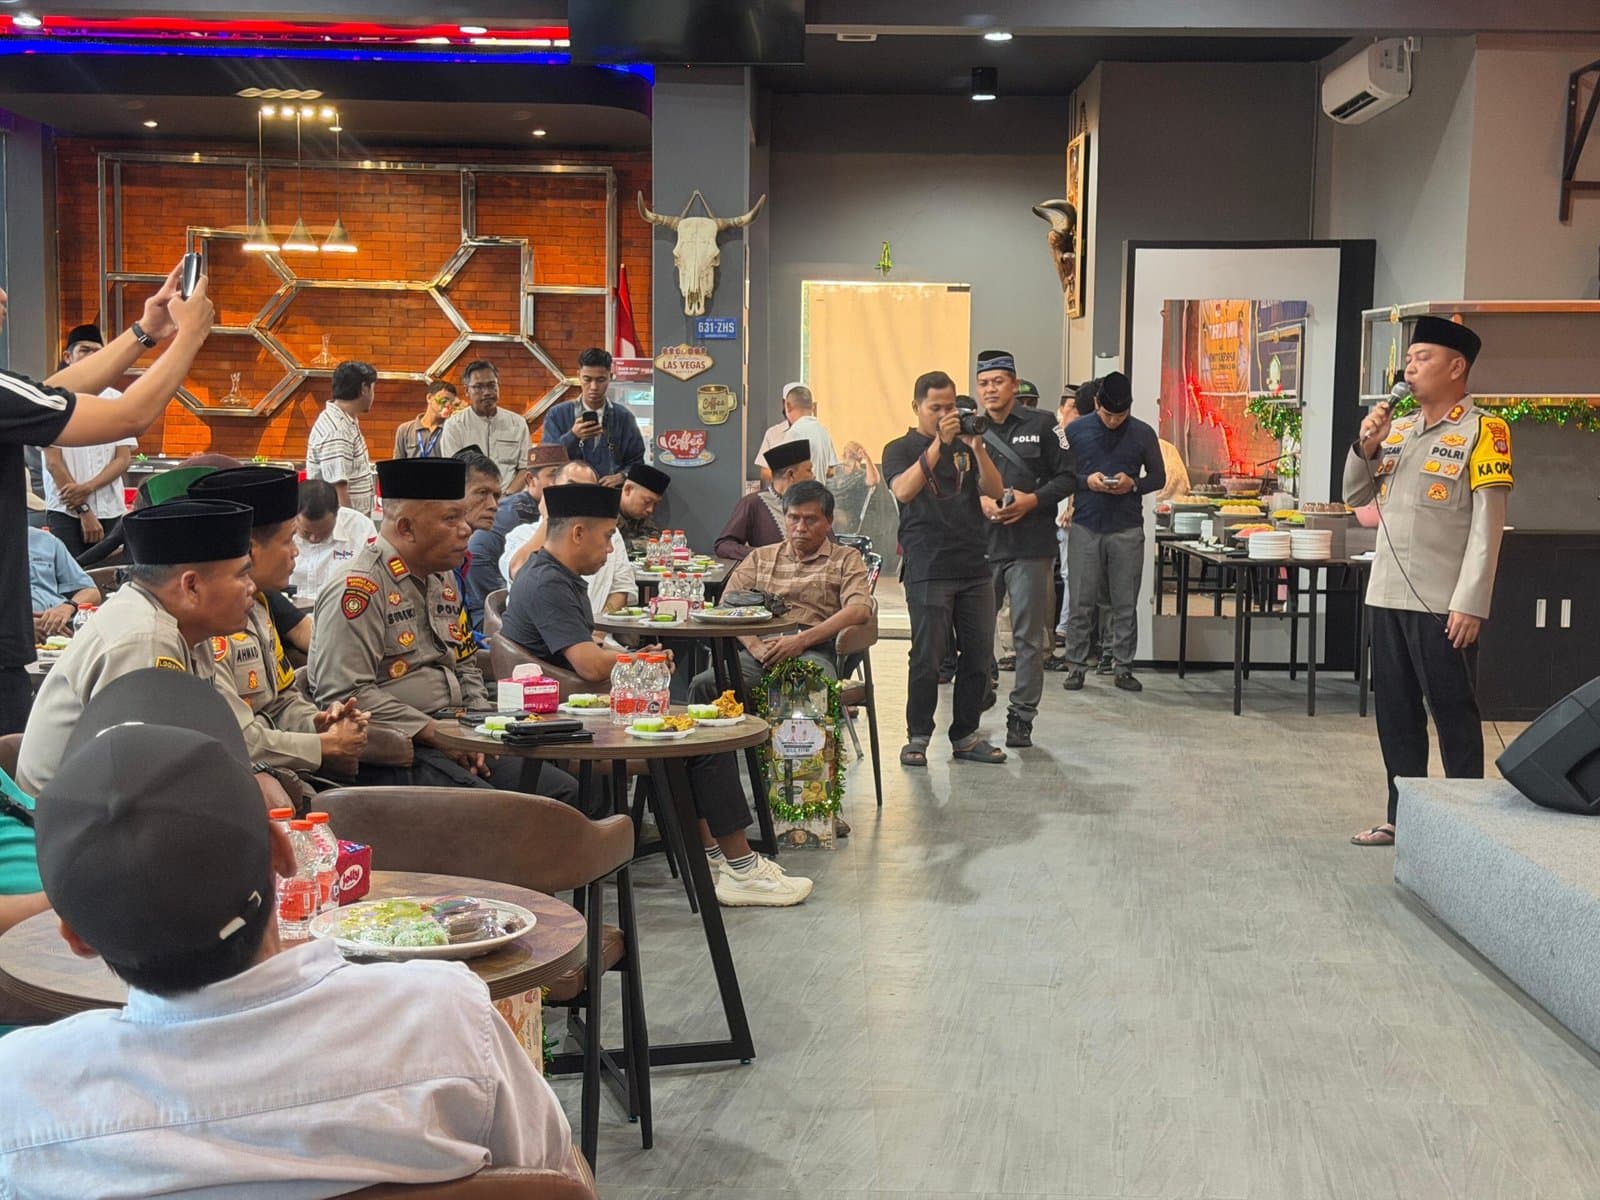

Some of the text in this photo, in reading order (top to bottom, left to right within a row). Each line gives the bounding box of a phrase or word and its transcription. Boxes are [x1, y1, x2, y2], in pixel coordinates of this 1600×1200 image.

[662, 360, 677, 370] LAS
[680, 360, 706, 370] VEGAS
[668, 430, 704, 450] Coffee
[1012, 435, 1040, 444] POLRI
[1431, 446, 1465, 460] POLRI
[1477, 462, 1493, 477] KA
